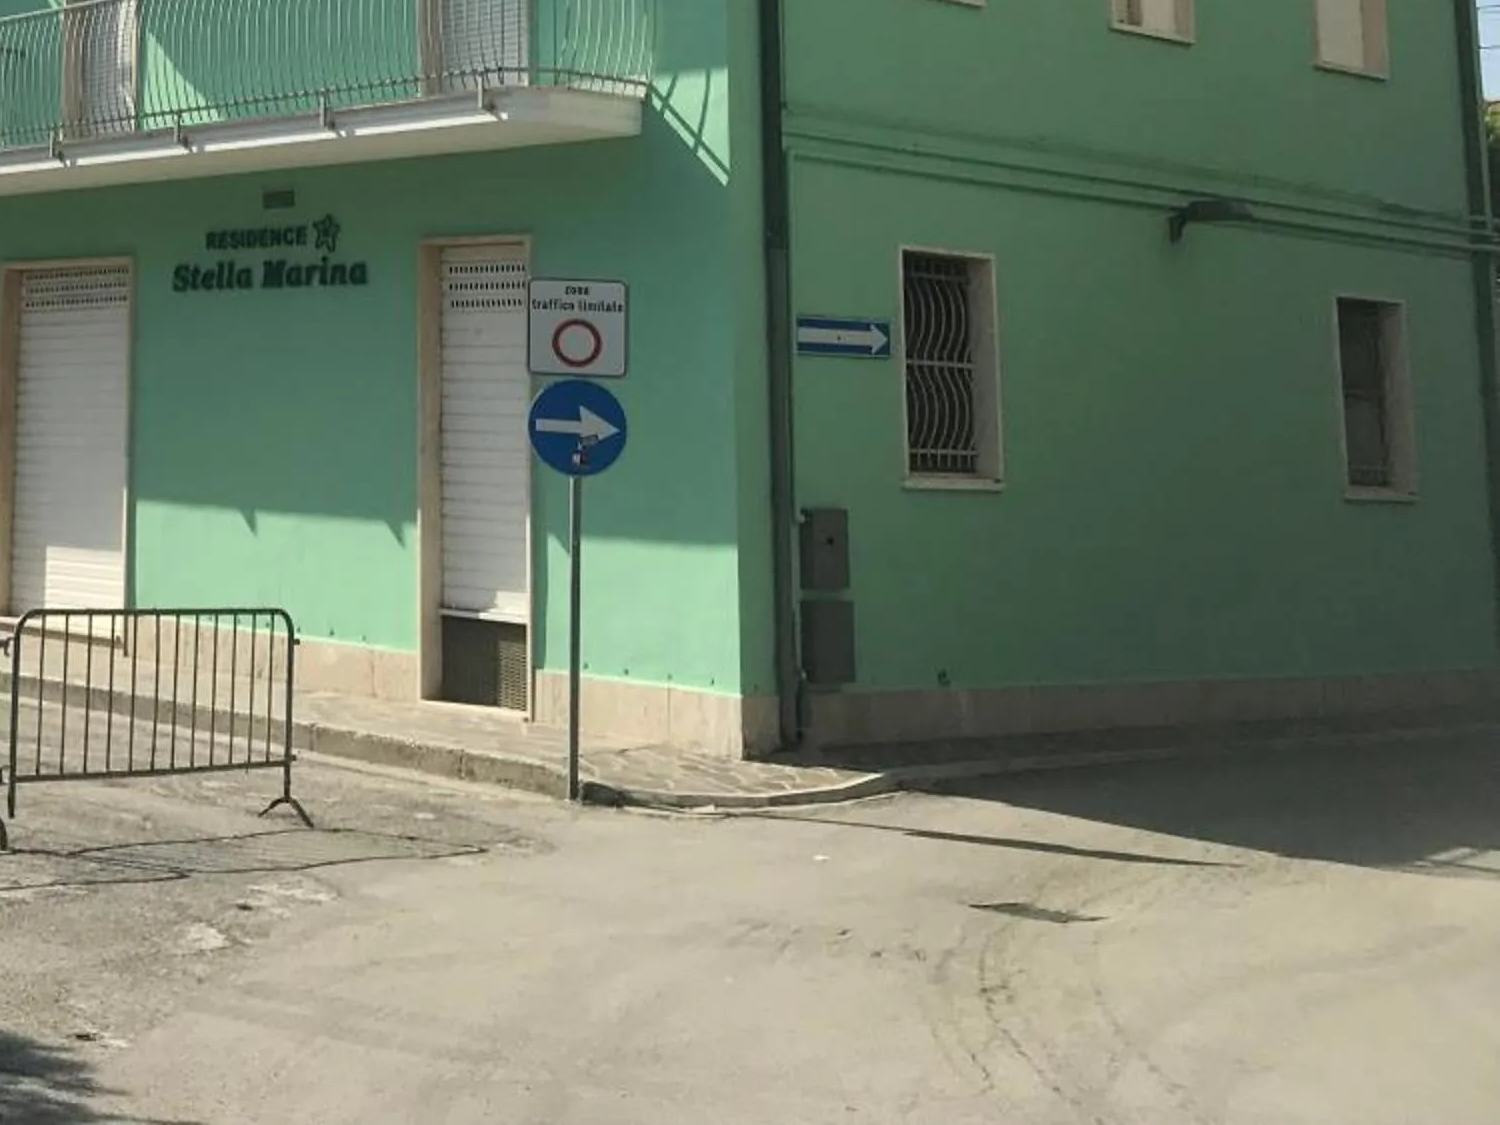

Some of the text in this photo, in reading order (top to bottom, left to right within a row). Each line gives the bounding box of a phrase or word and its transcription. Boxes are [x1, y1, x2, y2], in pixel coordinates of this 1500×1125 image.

[205, 226, 307, 250] RESIDENCE
[172, 256, 368, 292] Stella Marina
[565, 286, 589, 295] zona
[532, 299, 623, 312] traffico limitato
